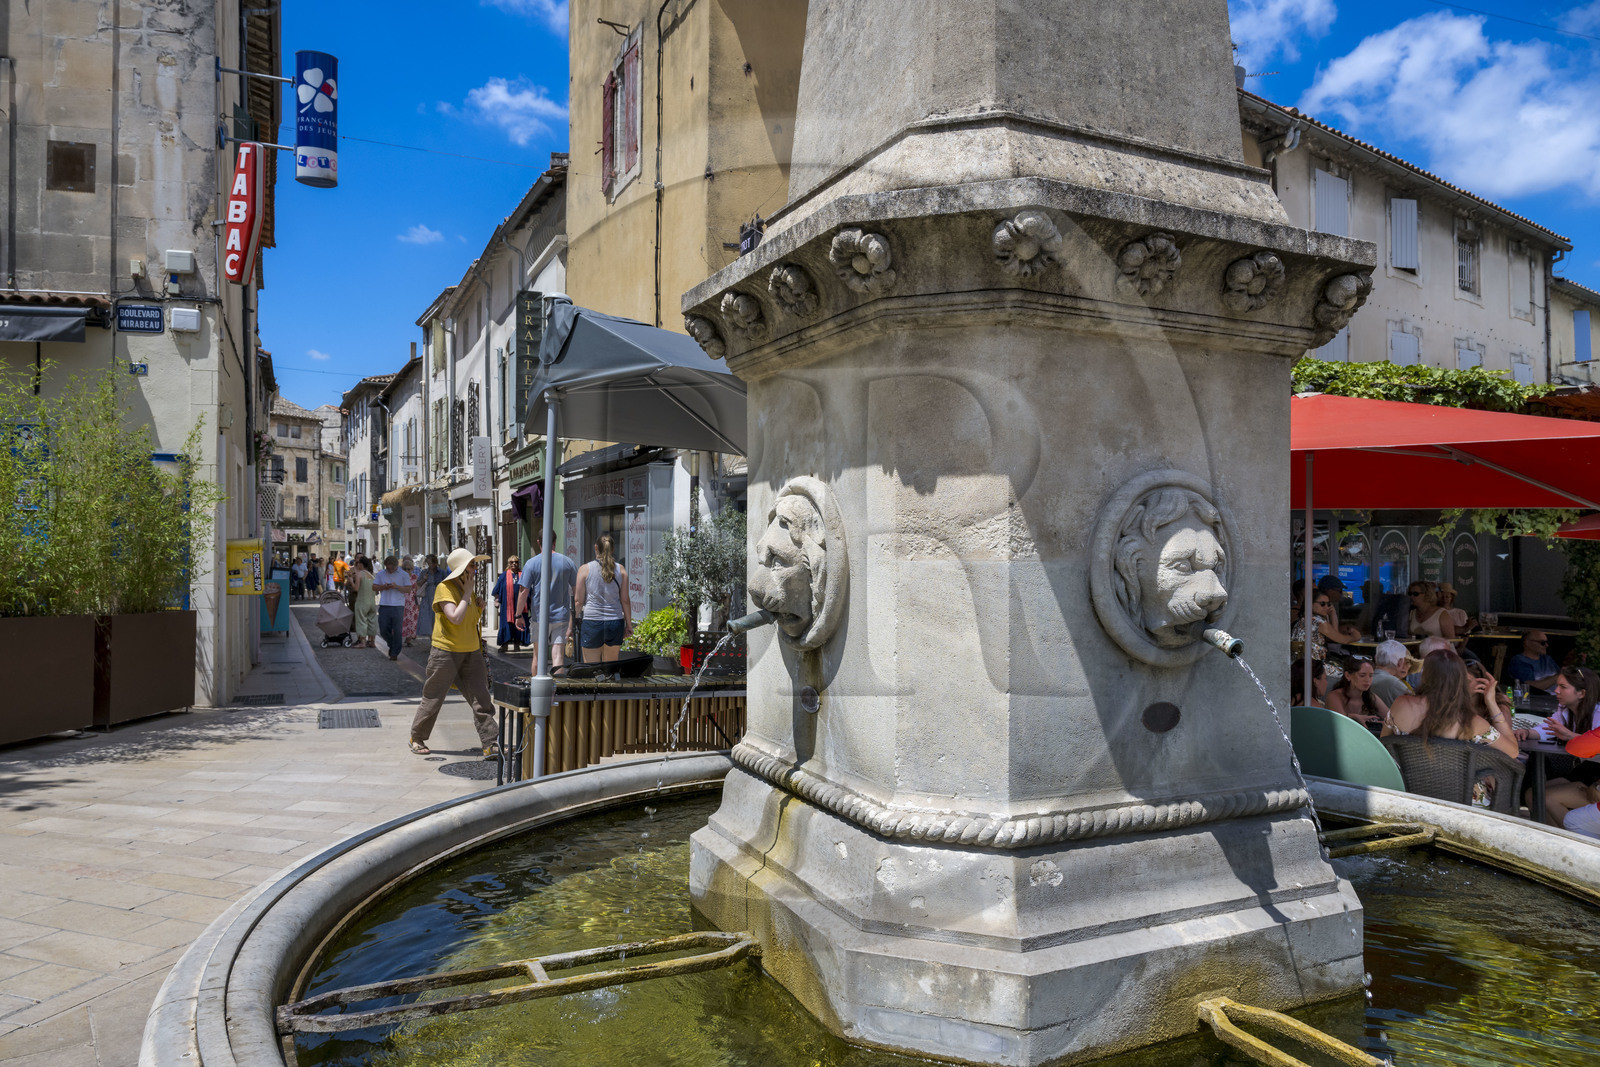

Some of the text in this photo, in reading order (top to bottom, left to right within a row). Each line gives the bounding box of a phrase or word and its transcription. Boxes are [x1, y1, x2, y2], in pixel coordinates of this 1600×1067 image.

[317, 127, 337, 137] JEUX
[297, 154, 337, 172] LOTO
[225, 147, 250, 276] TABAC
[119, 308, 160, 318] BOULEVARD
[120, 319, 160, 329] MIRABEAU
[478, 444, 487, 492] GALLERY
